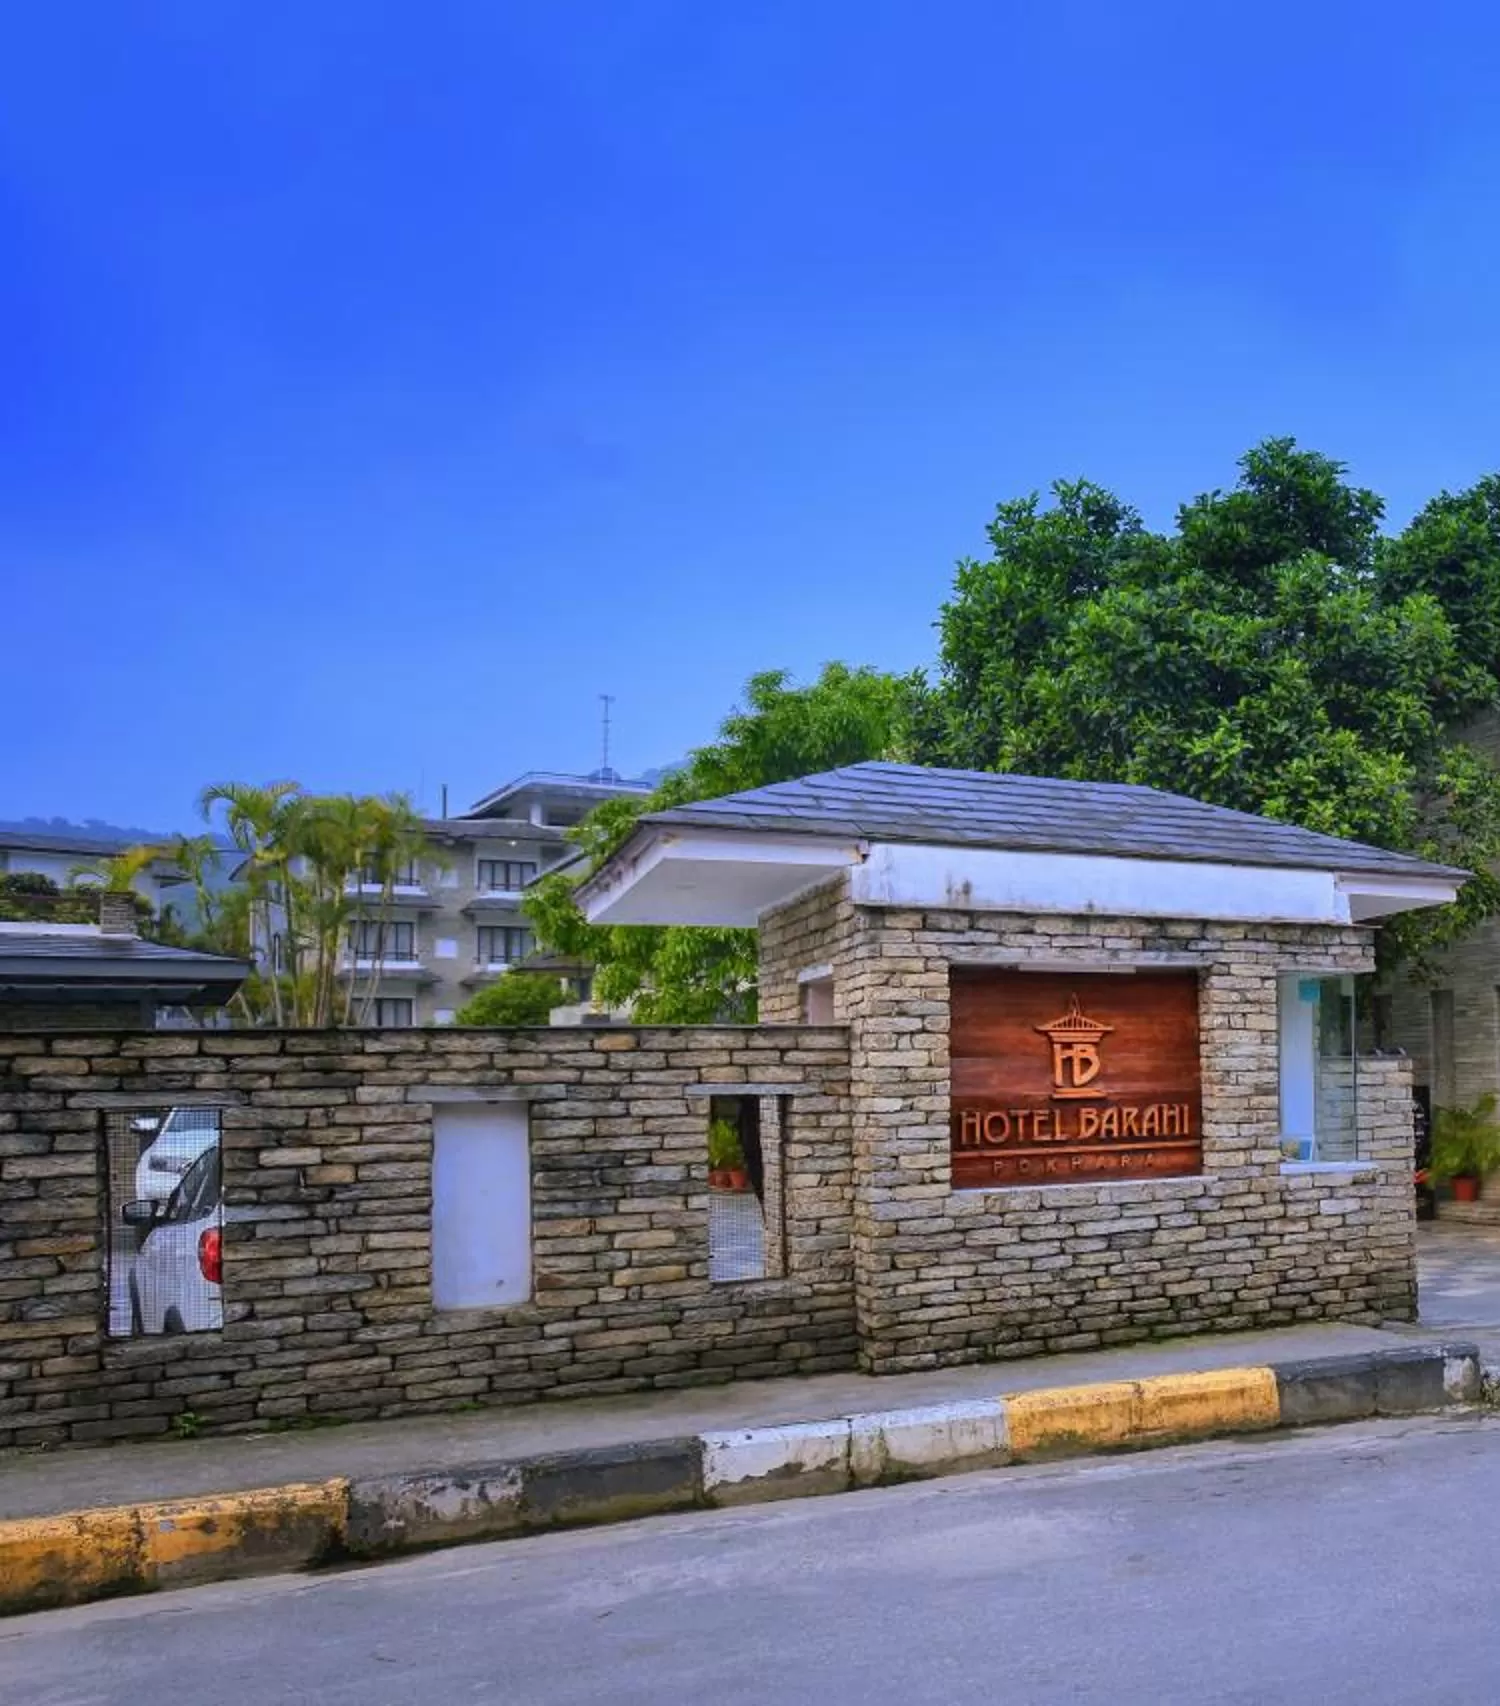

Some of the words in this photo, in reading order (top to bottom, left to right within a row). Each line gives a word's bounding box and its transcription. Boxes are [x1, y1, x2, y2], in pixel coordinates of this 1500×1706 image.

[960, 1109, 1070, 1145] HOTEL
[1079, 1103, 1190, 1138] BARAHI
[993, 1154, 1154, 1173] POKHARA
